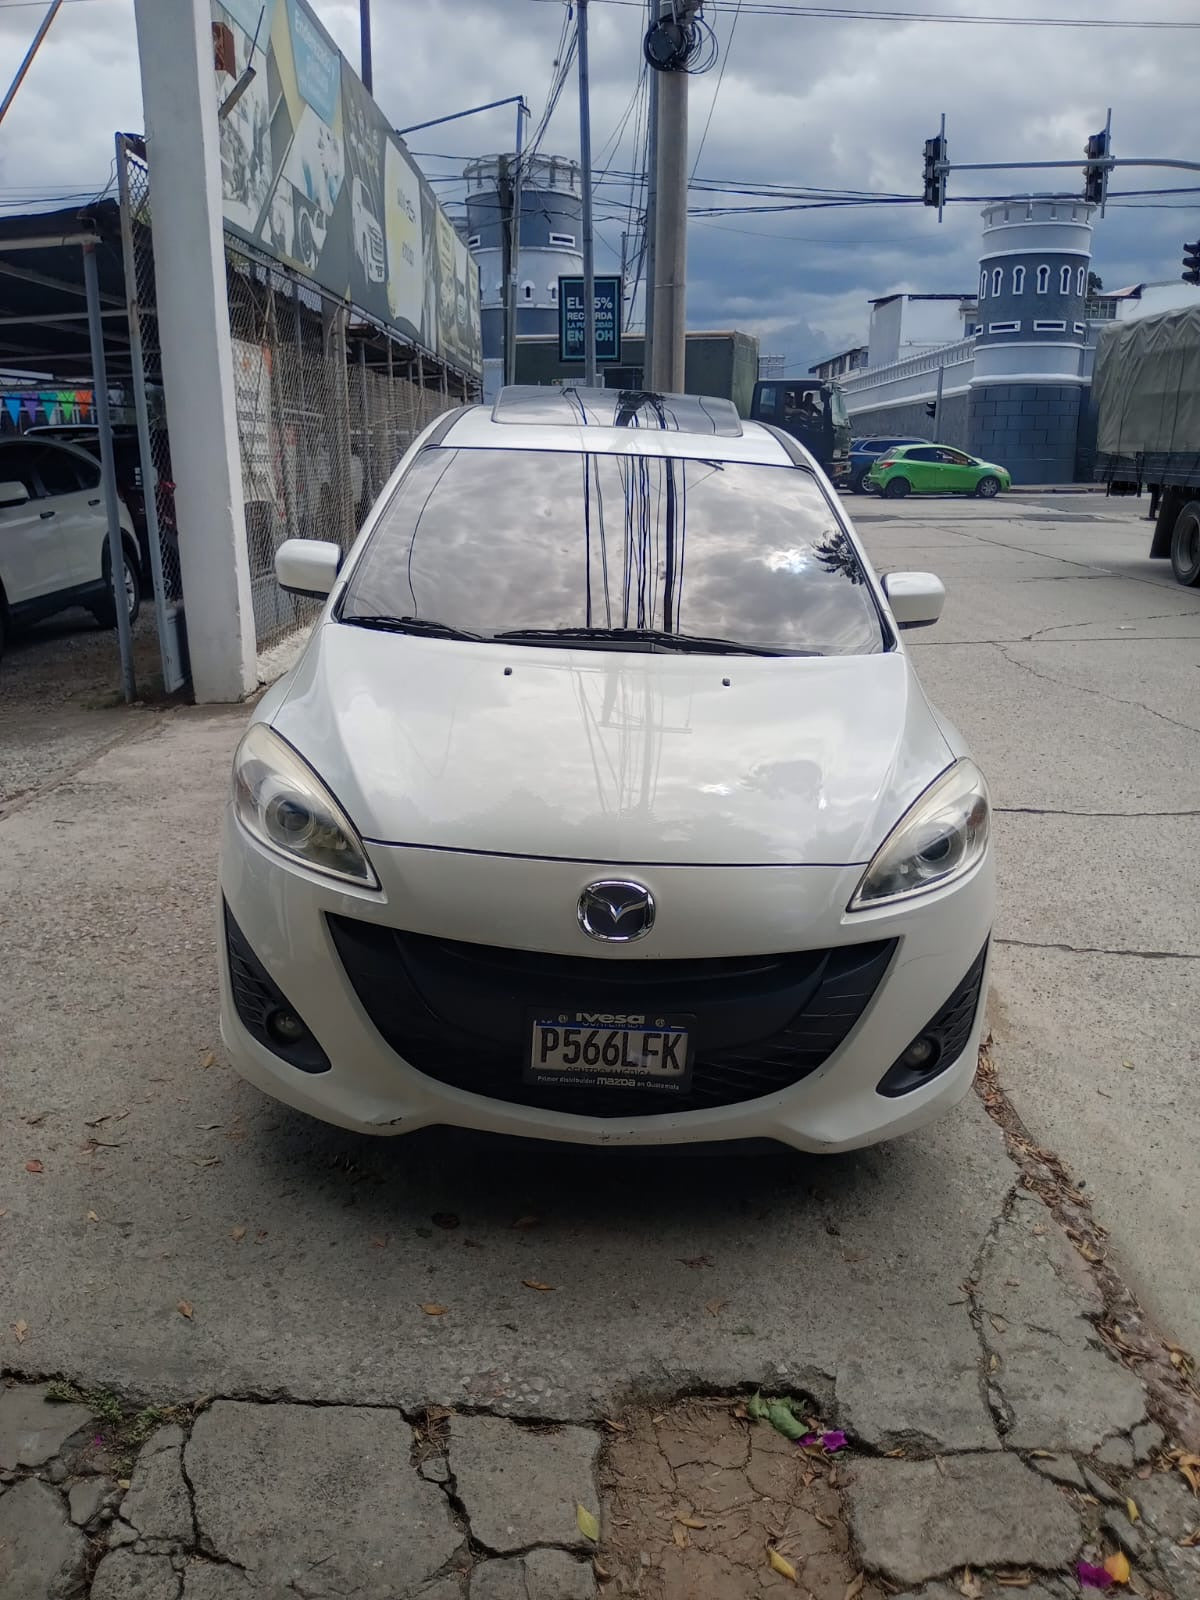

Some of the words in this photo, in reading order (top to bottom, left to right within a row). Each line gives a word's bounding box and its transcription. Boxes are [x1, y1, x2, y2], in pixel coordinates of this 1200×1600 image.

[567, 296, 584, 309] EL
[567, 312, 613, 320] RECRDA
[567, 330, 584, 341] EN
[540, 1027, 683, 1070] P566LFK
